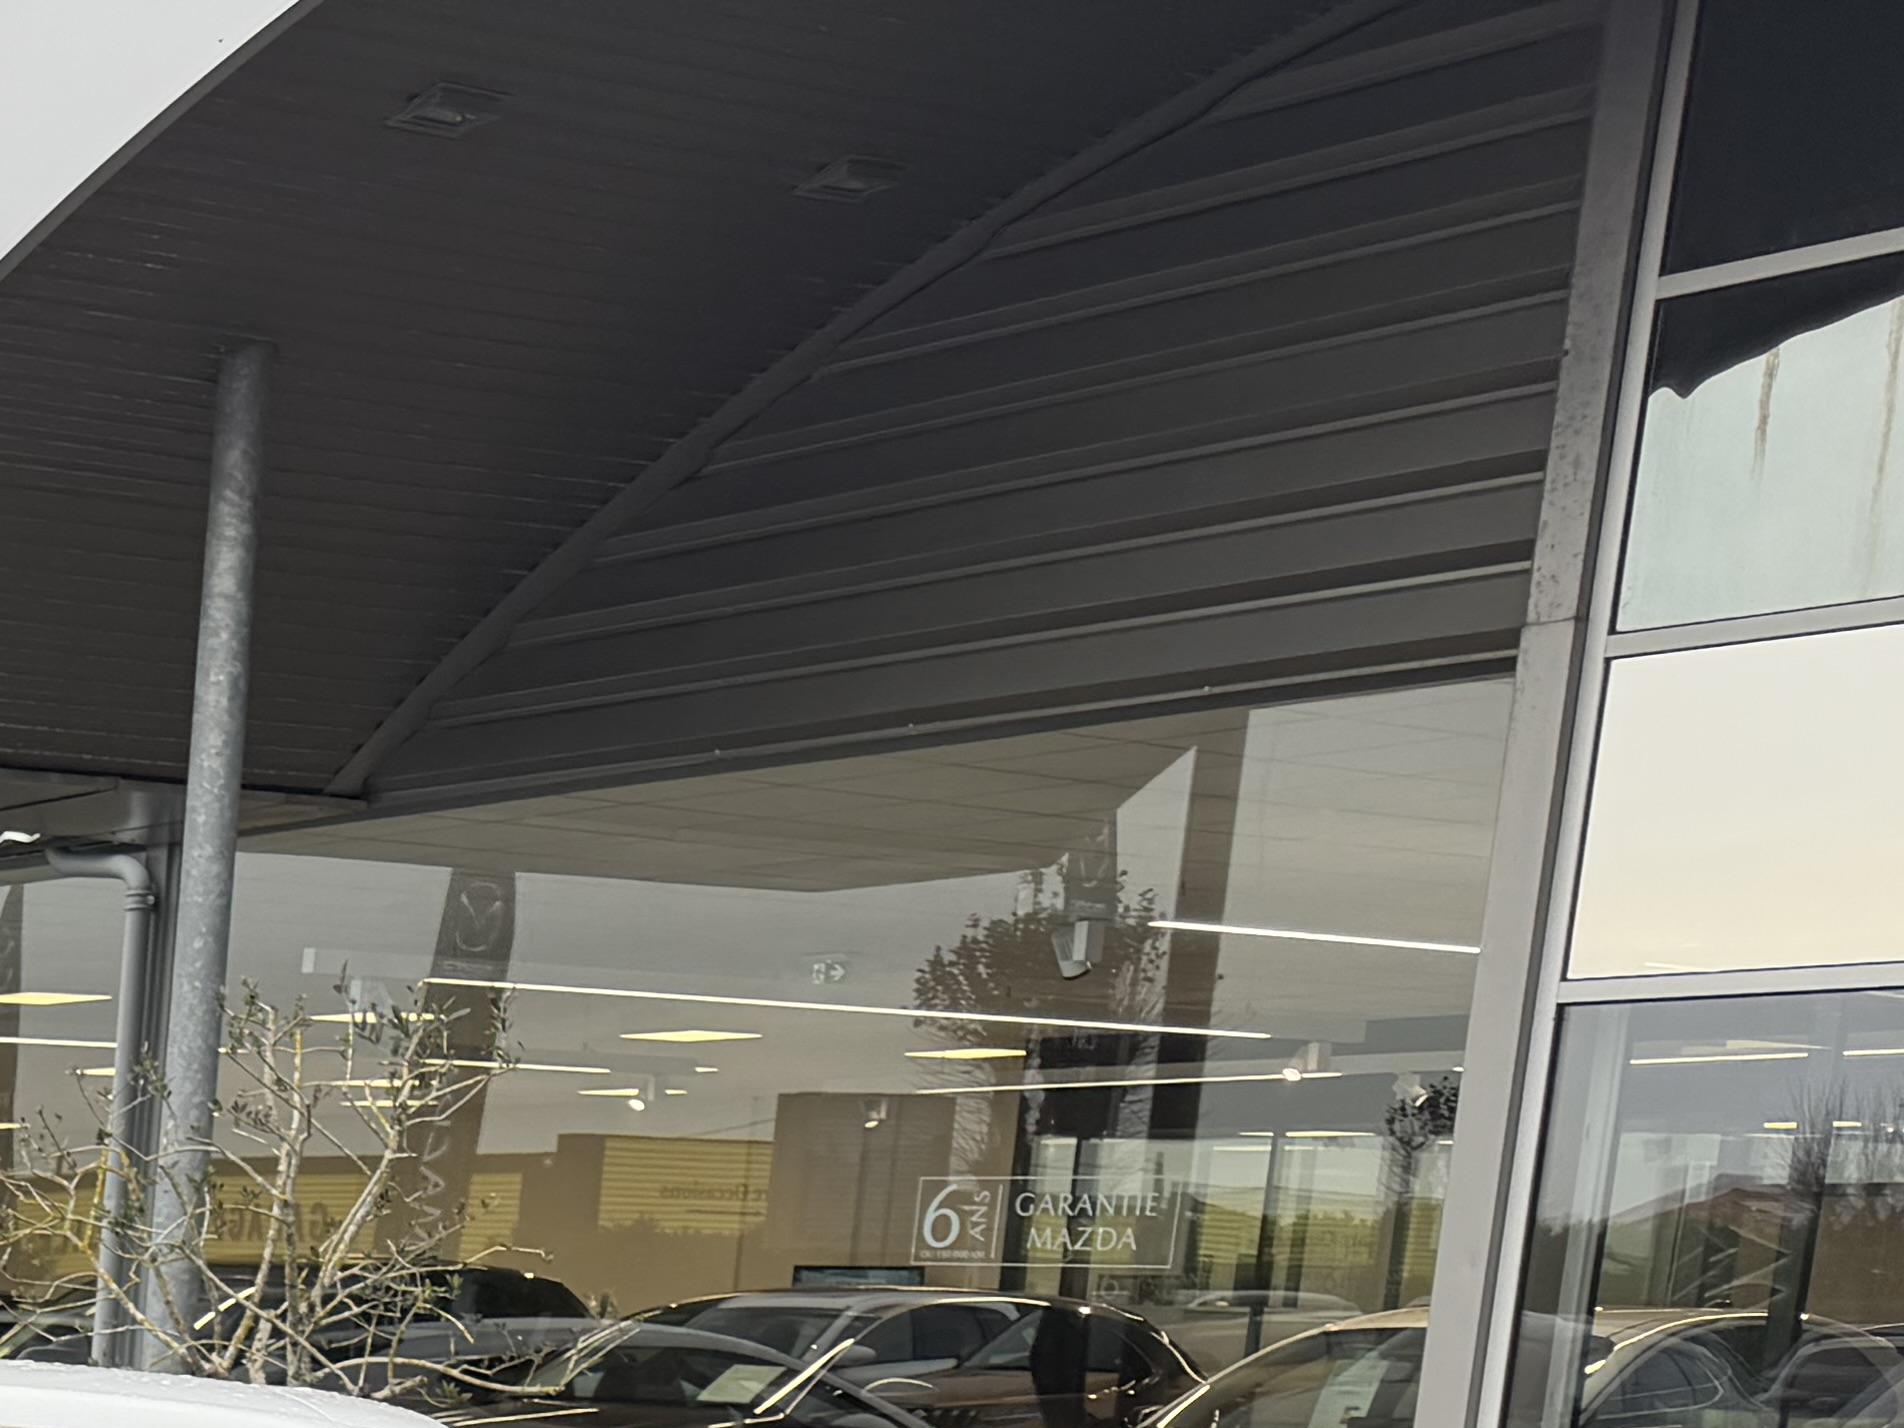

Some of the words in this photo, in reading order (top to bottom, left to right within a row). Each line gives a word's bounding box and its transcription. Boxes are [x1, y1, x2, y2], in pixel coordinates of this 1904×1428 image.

[923, 1183, 961, 1249] 6
[968, 1190, 991, 1242] ANS
[1015, 1192, 1160, 1217] GARANTIE
[1026, 1226, 1137, 1250] MAZDA
